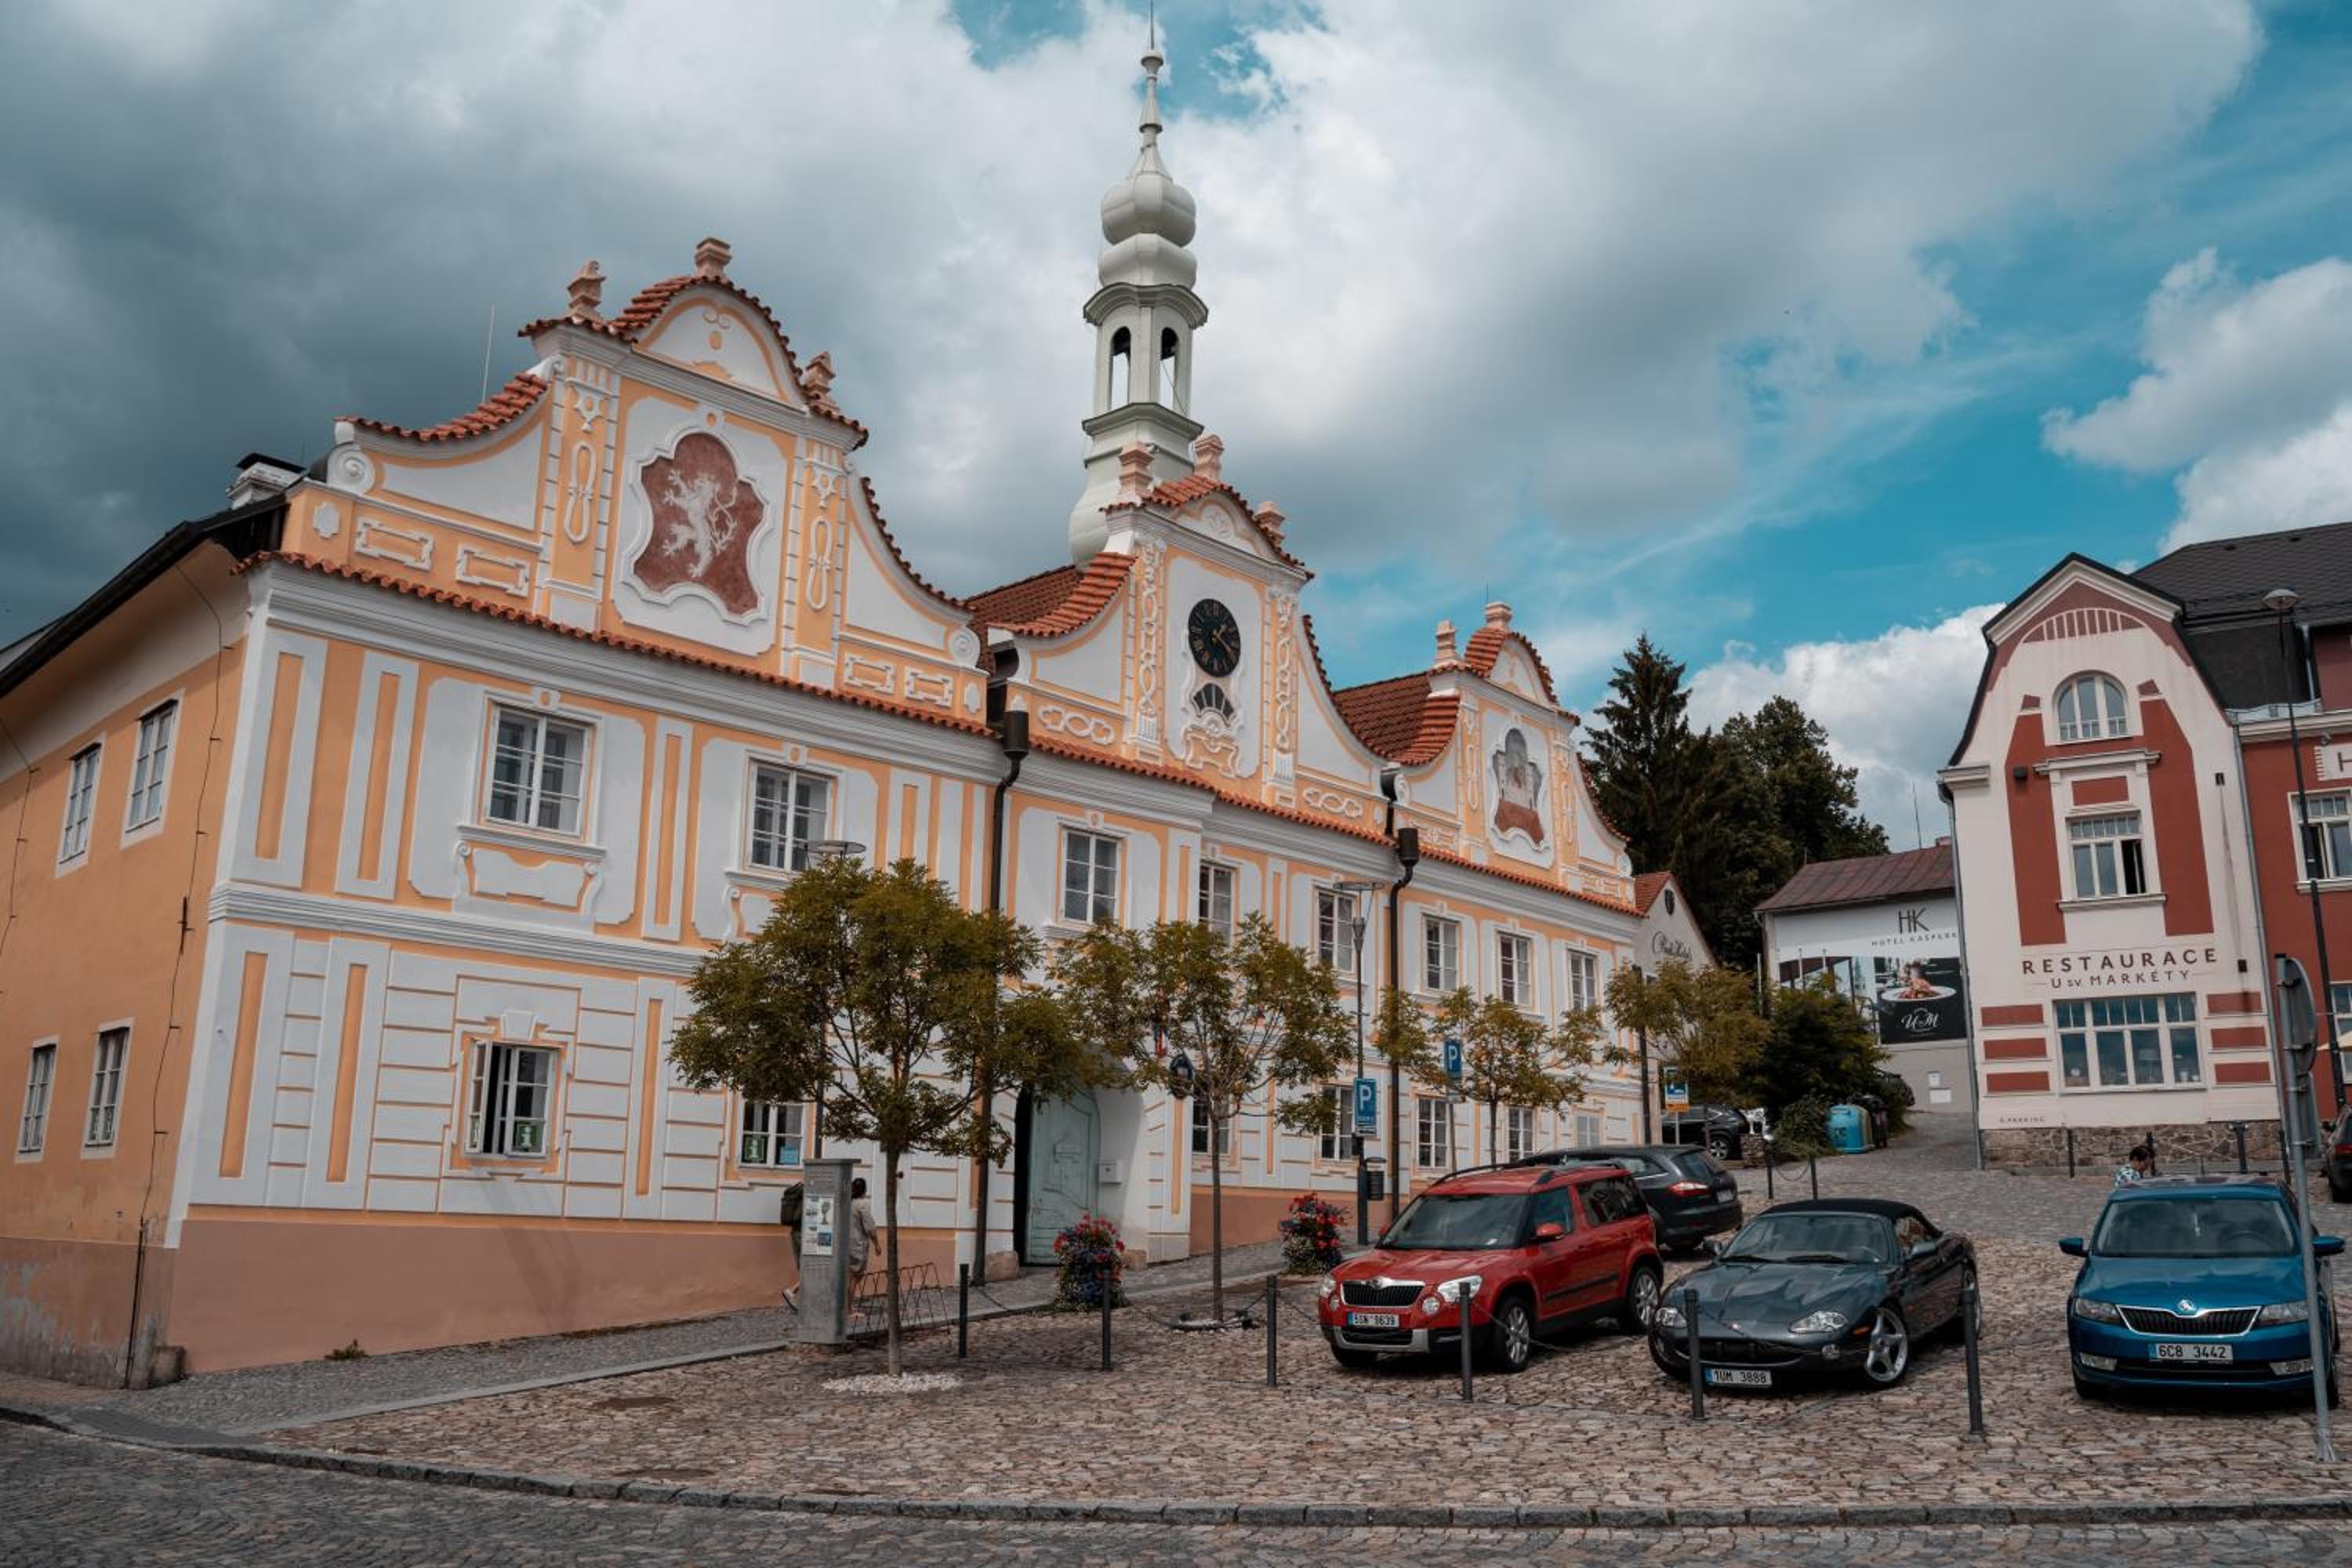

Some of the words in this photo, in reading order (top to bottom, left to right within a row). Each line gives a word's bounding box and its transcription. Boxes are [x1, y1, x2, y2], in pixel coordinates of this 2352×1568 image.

[1898, 906, 1930, 935] HK
[1871, 937, 1904, 947] HOTEL
[2022, 948, 2217, 975] RESTAURACE
[2051, 978, 2062, 989] U
[2090, 970, 2190, 985] MARKÉTY
[1359, 1084, 1372, 1111] P
[2158, 1345, 2183, 1357] 6C8
[2193, 1345, 2227, 1359] 3442
[1714, 1369, 1733, 1381] 1UM
